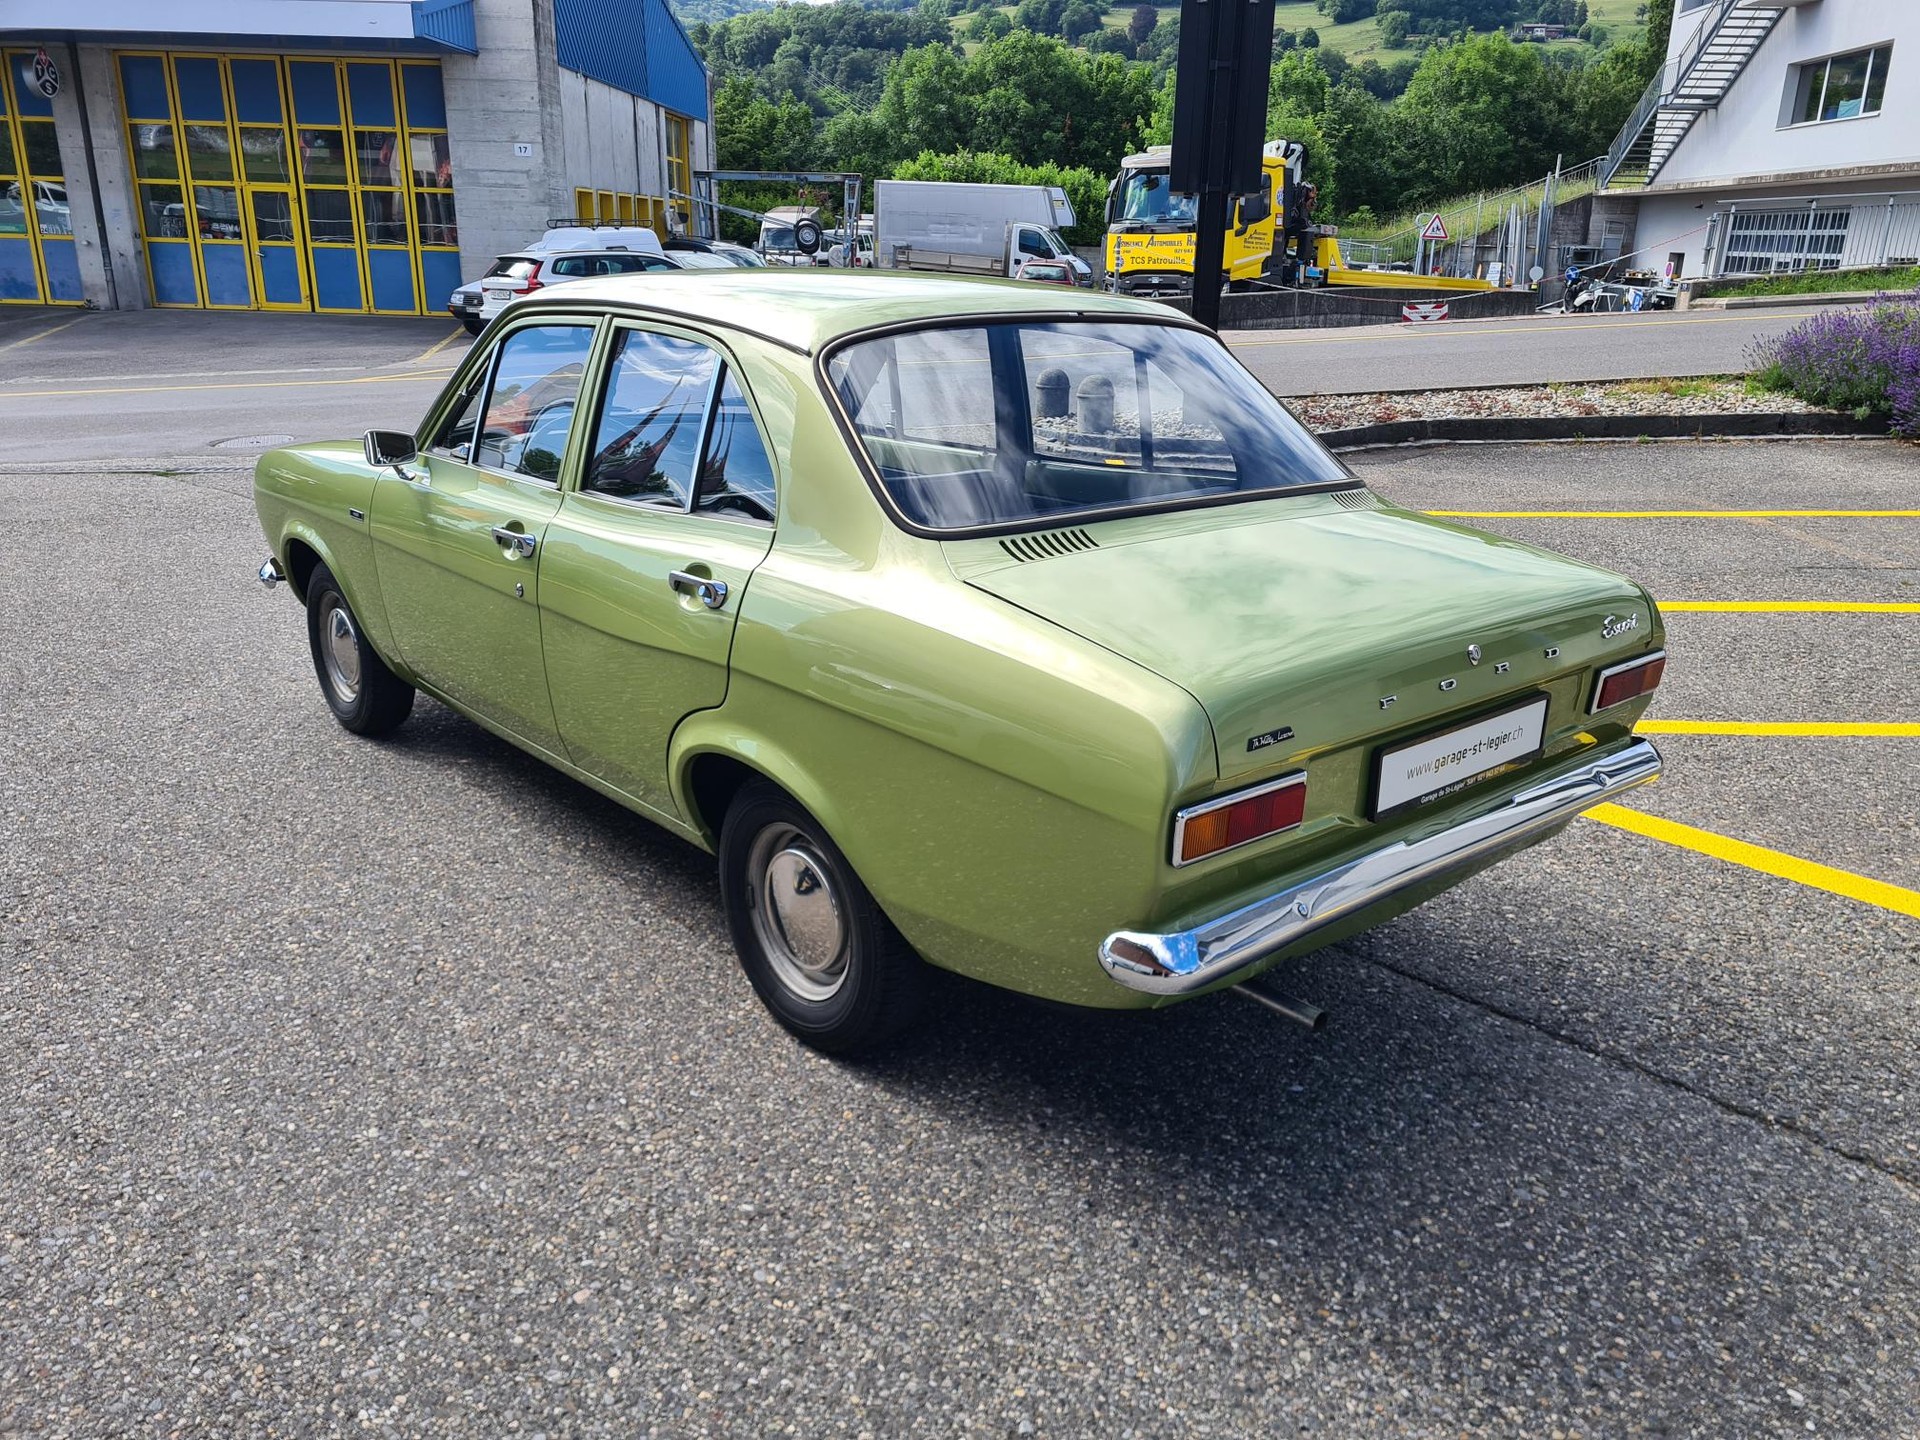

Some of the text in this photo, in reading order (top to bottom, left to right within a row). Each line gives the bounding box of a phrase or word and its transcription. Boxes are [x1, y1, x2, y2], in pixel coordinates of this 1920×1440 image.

[35, 64, 56, 94] TCS
[518, 146, 528, 154] 17
[1131, 256, 1185, 265] TCS Patrouille
[1602, 613, 1639, 639] Escort
[1379, 647, 1560, 710] FORD
[1407, 725, 1523, 779] www.garage-st-legier.ch
[1420, 793, 1438, 804] Garage
